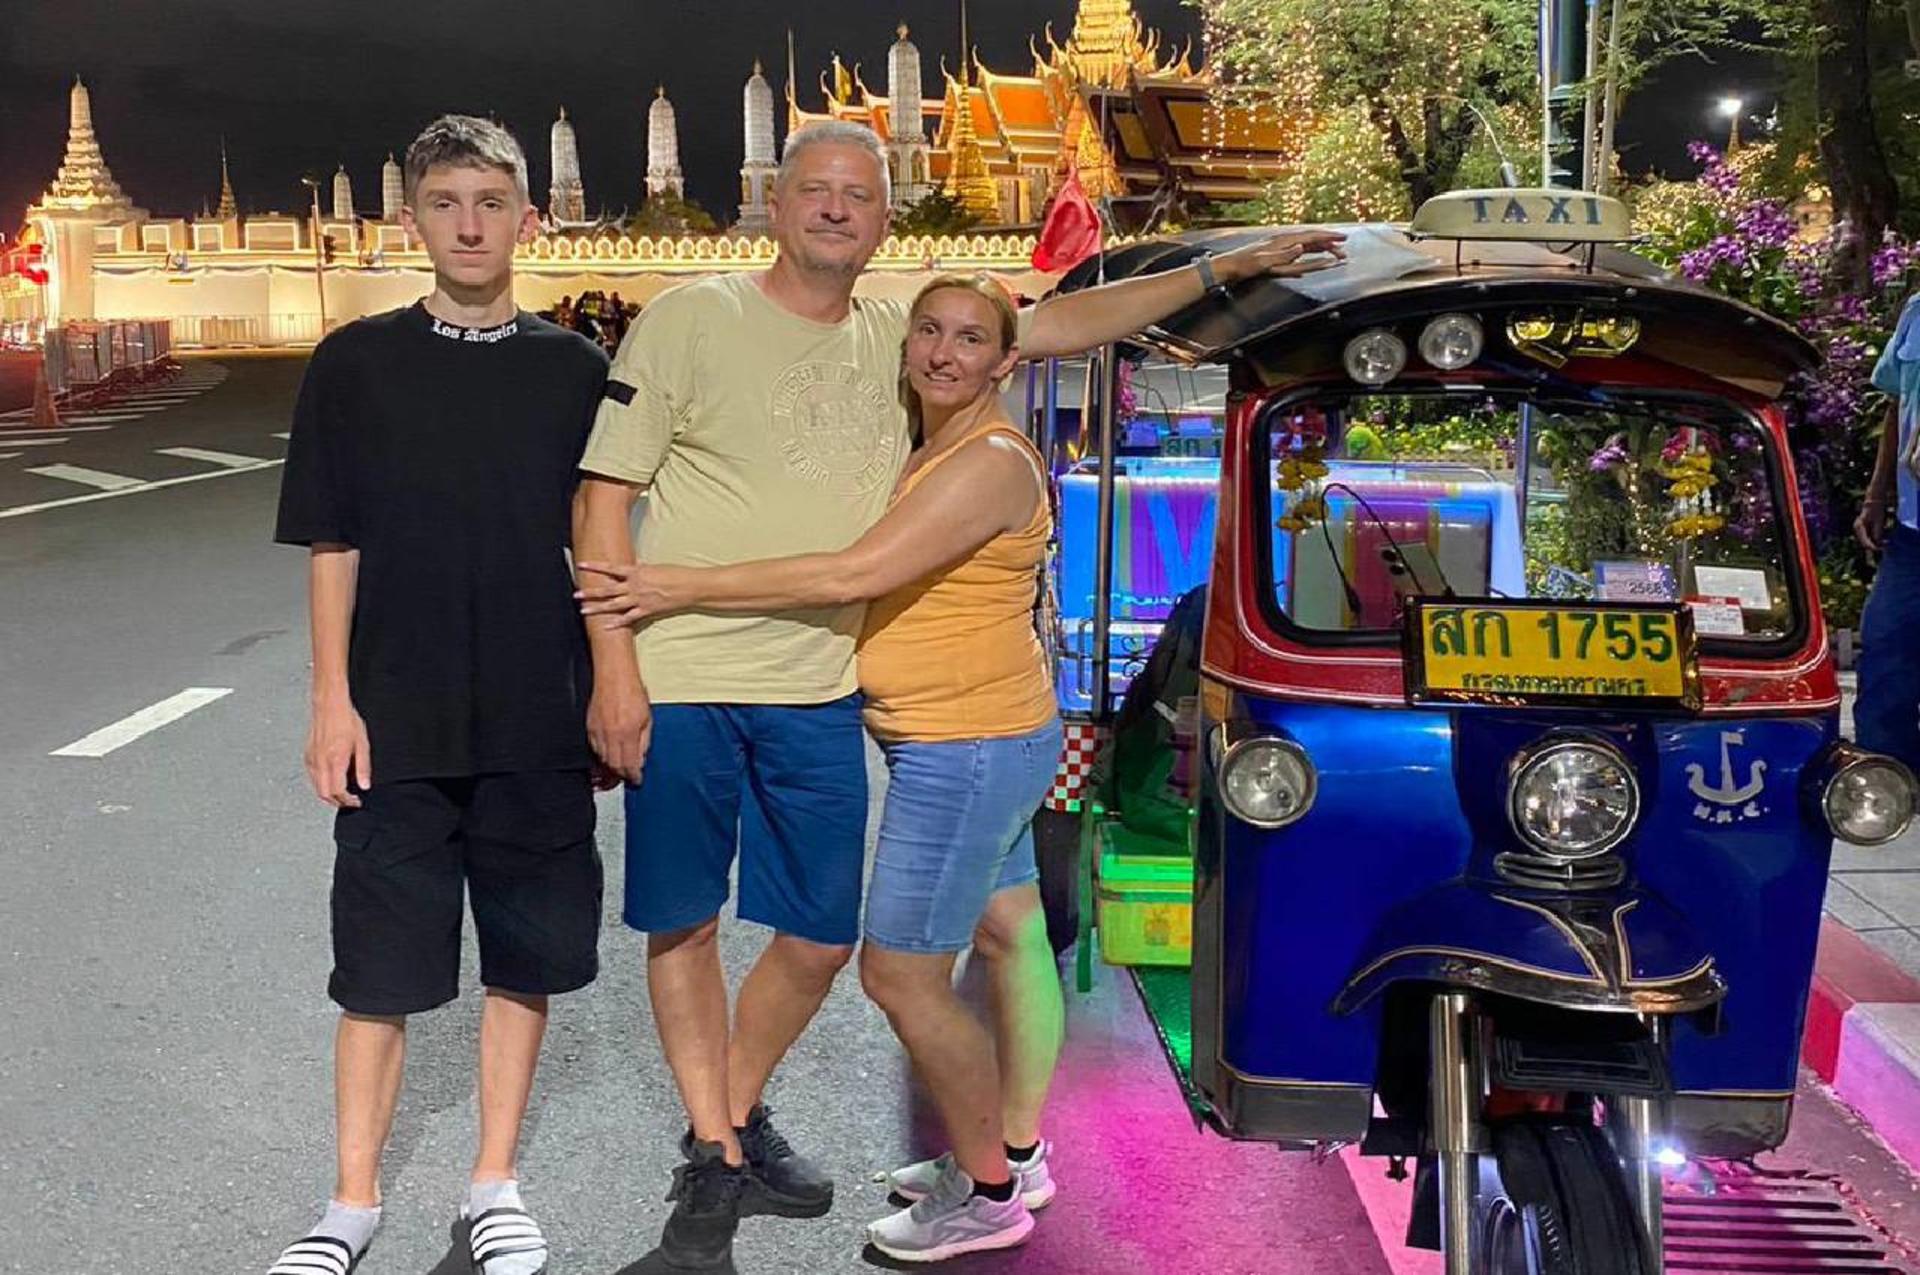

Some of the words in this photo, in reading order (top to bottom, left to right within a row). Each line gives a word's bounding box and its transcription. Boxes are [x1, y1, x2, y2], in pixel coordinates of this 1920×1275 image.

[1465, 196, 1603, 224] TAXI
[433, 318, 461, 339] Los
[1429, 607, 1512, 658] สก
[1538, 610, 1674, 663] 1755
